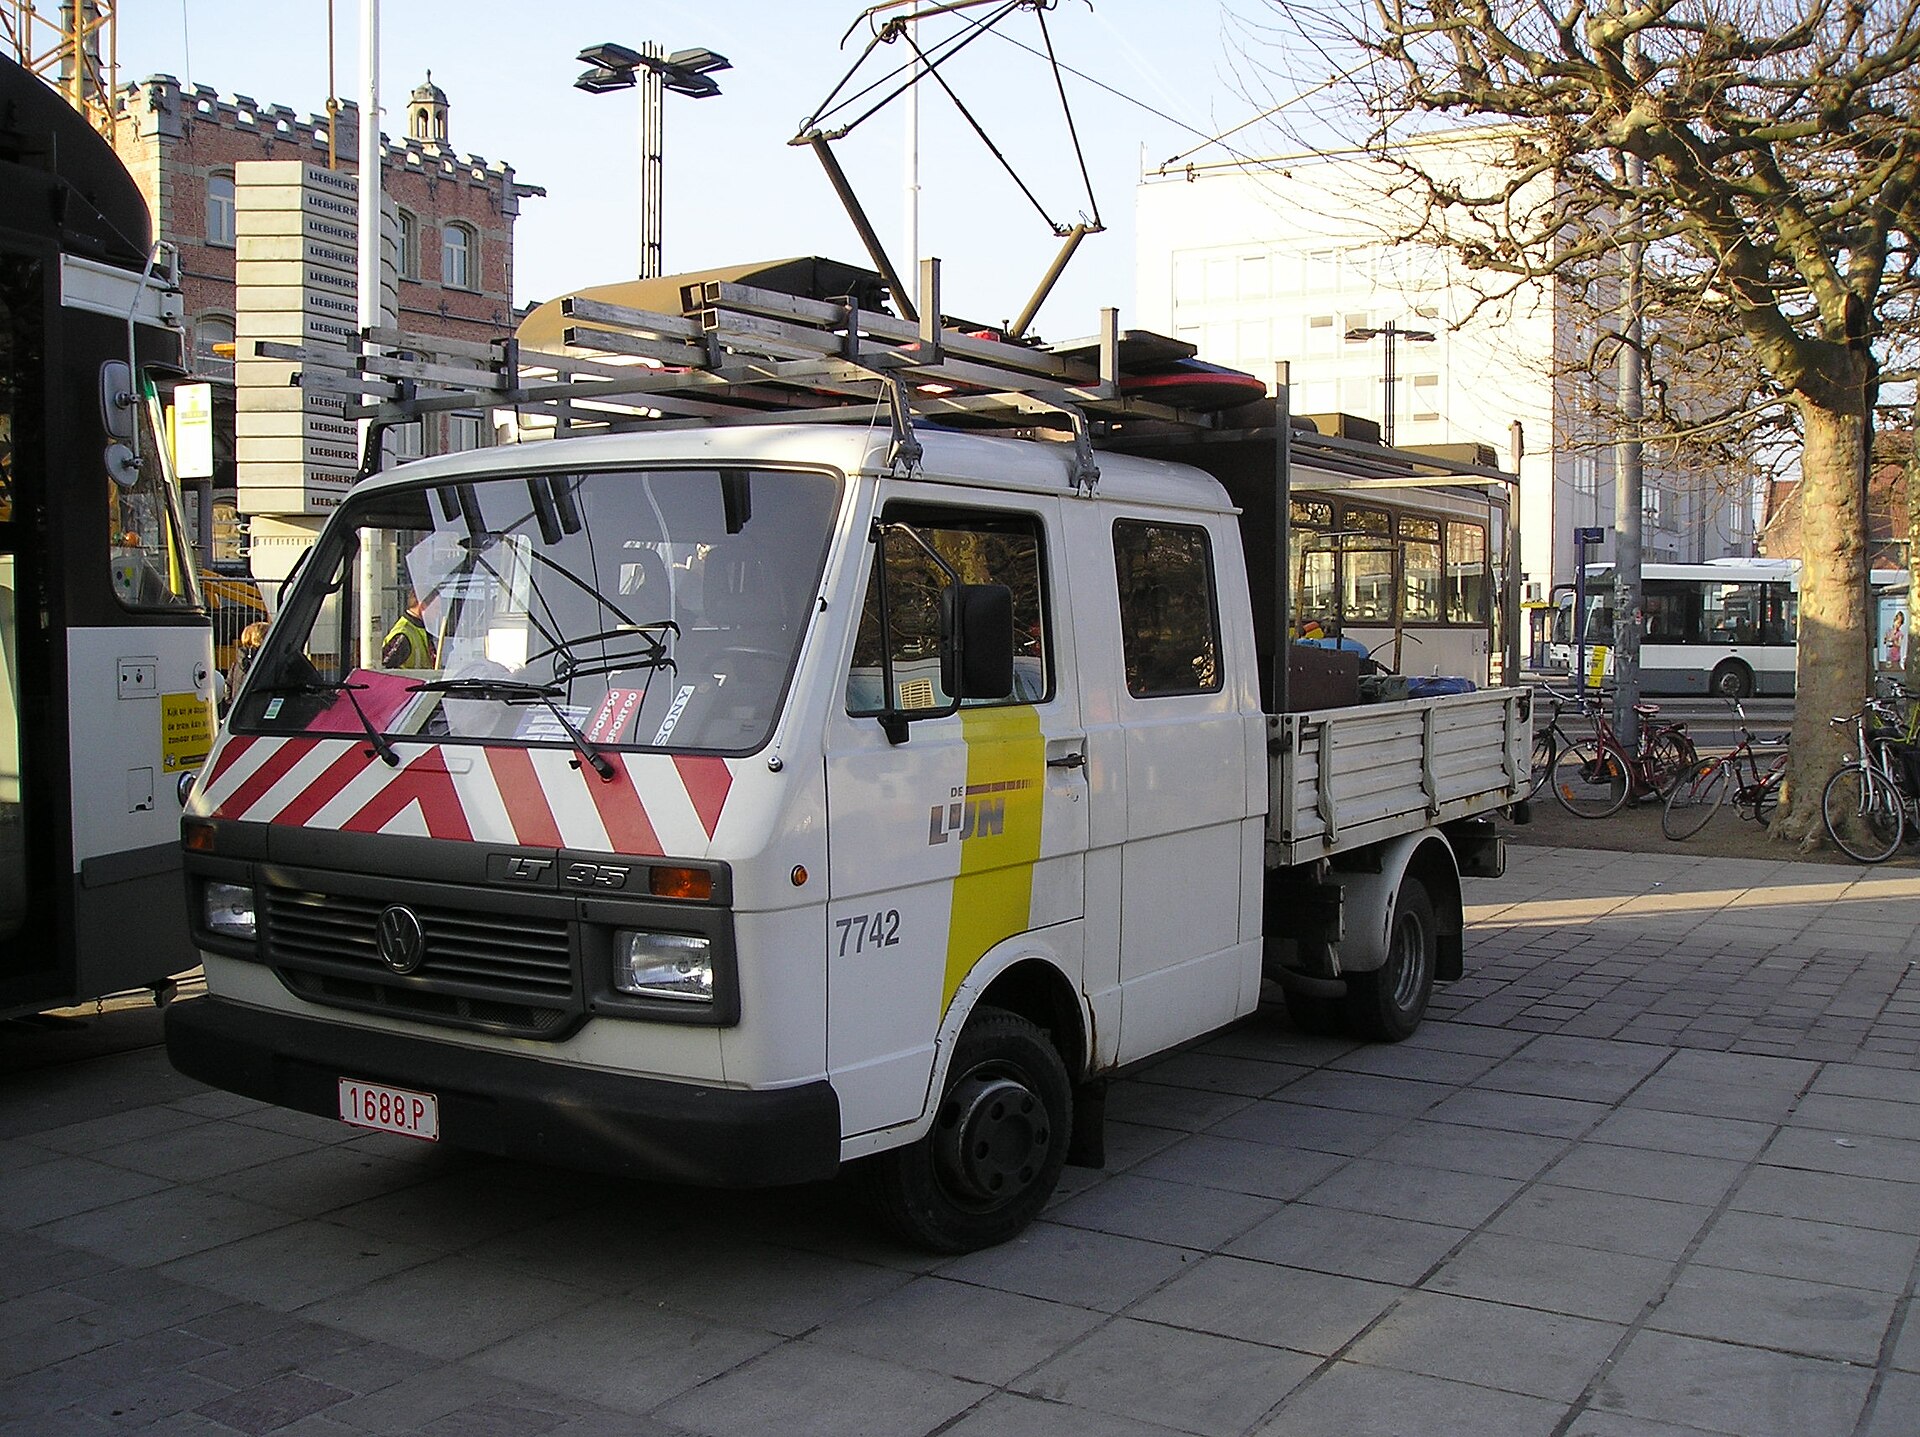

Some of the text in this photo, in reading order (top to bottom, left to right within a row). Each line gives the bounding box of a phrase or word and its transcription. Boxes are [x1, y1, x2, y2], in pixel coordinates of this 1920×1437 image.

[309, 171, 358, 192] LIEBHERR
[309, 197, 358, 217] LIEBHERR
[309, 221, 358, 241] LIEBHERR
[309, 246, 358, 266] LIEBHERR
[309, 271, 358, 290] LIEBHERR
[309, 296, 358, 314] LIEBHERR
[309, 421, 358, 436] LIEBHERR
[310, 446, 358, 461] LIEBHERR
[588, 691, 621, 742] SPORT 90
[605, 692, 638, 743] SPORT 90
[654, 689, 691, 745] SONY
[950, 786, 964, 798] DE
[928, 797, 1005, 846] LIJN
[503, 857, 631, 889] LT 35
[836, 909, 901, 958] 7742
[349, 1086, 425, 1131] 1688.P
